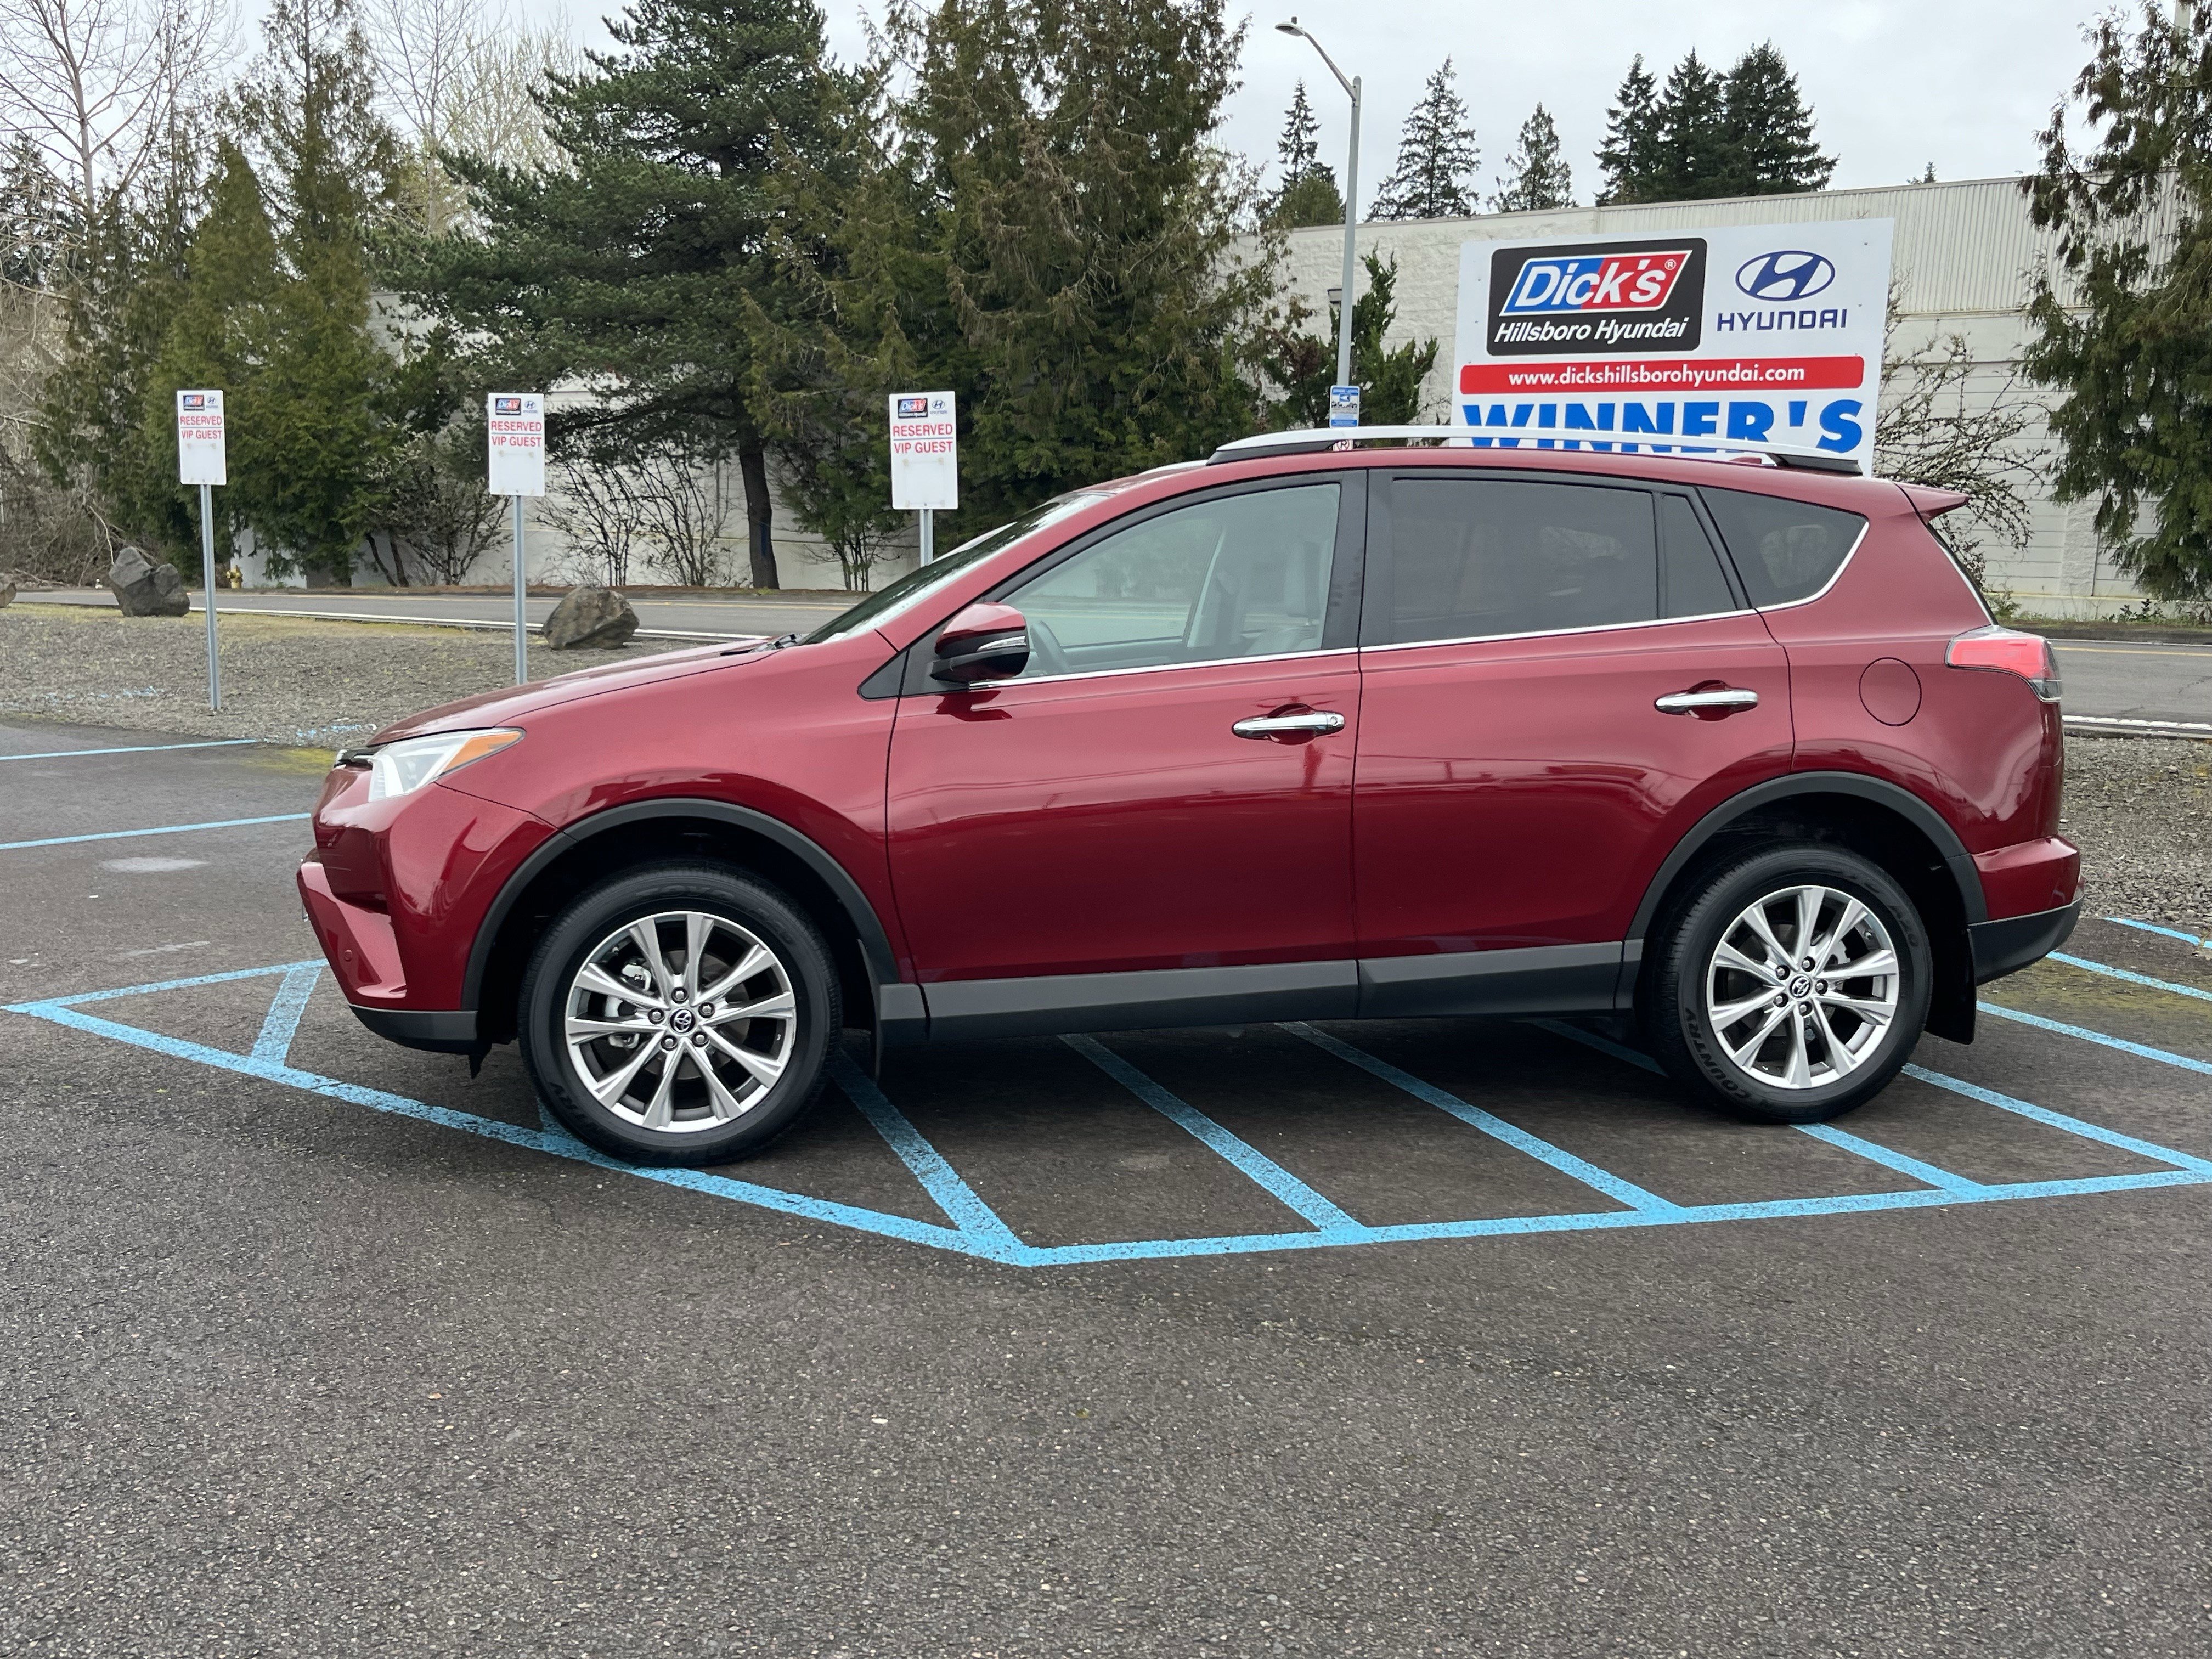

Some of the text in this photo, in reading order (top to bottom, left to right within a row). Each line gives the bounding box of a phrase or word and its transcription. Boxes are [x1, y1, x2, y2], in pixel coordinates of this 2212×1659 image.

[1717, 309, 1847, 332] HYUNDAI
[1494, 317, 1690, 344] Hillsboro Hyundai
[1509, 364, 1805, 387] www.dickshillsborohyundai.com
[180, 416, 222, 426] RESERVED
[491, 421, 542, 432] RESERVED
[1462, 399, 1863, 454] WINNER'S
[181, 430, 222, 439] VIP GUEST
[893, 424, 952, 437] RESERVED
[492, 436, 542, 447] VIP GUEST
[894, 441, 953, 454] VIP GUEST
[1685, 1007, 1752, 1098] COUNTRY
